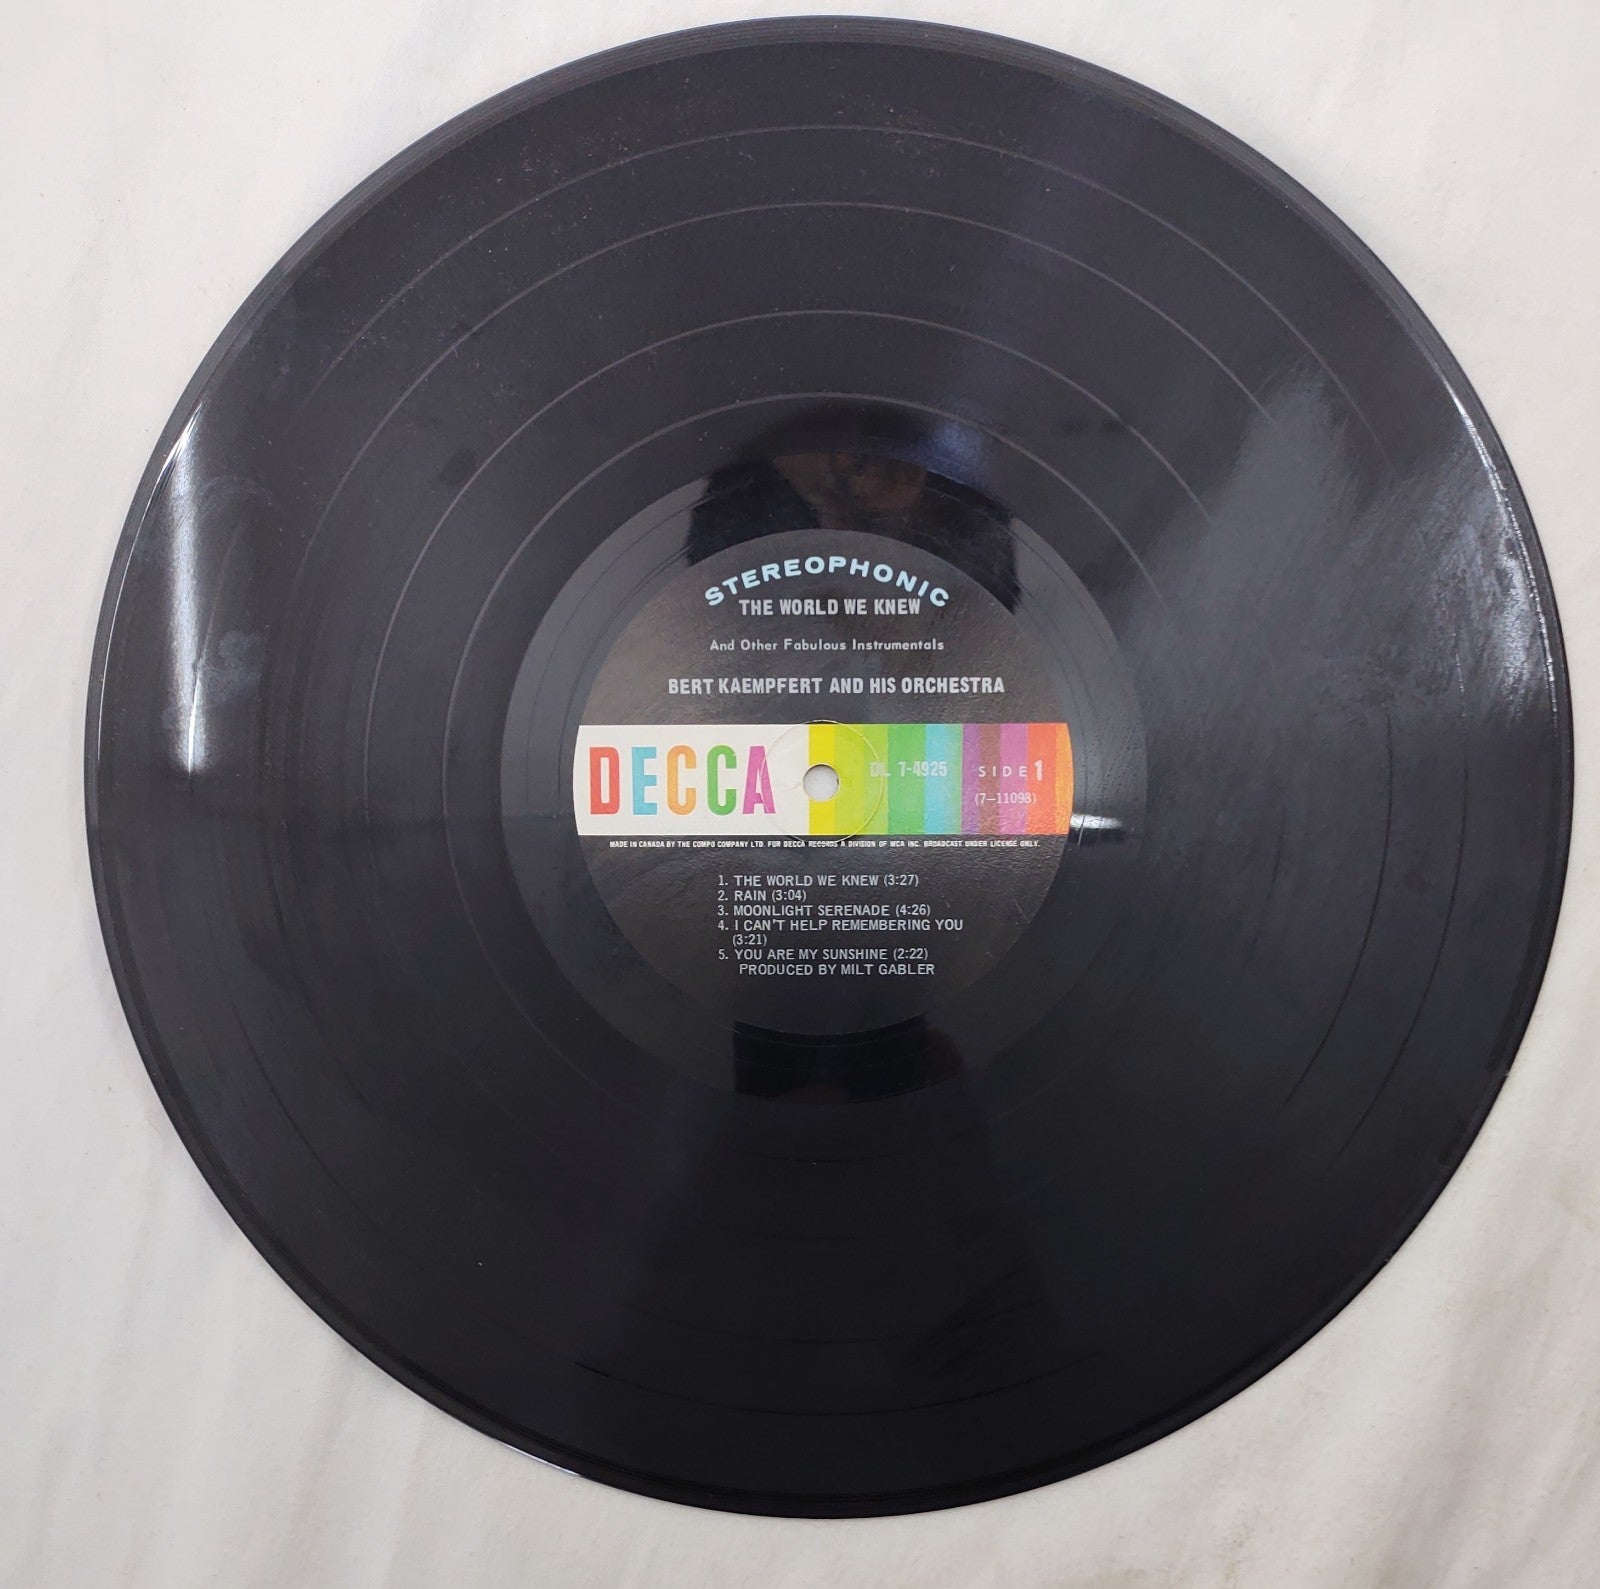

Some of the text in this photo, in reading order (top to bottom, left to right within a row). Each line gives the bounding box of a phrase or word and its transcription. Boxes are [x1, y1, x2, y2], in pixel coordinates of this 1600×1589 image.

[705, 556, 949, 607] STEREOPHONIC
[739, 599, 921, 616] THE WORLD WE KNEW
[709, 639, 944, 651] And Other Fabulous Instrumentals
[669, 677, 1005, 694] BERT KAEMPFERT AND HIS ORCHESTRA
[898, 762, 948, 777] 7-4925
[978, 760, 1043, 781] SIDE 1
[589, 745, 776, 815] DECCA
[609, 840, 628, 848] MADE
[629, 840, 638, 848] IN
[638, 840, 665, 848] CANADA
[666, 840, 675, 848] BY
[677, 840, 691, 848] THE
[717, 840, 749, 848] COMPANY
[783, 840, 806, 848] DECCA
[808, 840, 838, 848] RECORDS
[840, 840, 846, 848] A
[848, 840, 876, 848] DIVISION
[878, 840, 888, 848] OF
[890, 840, 905, 848] MCA
[923, 840, 963, 848] BROADCAST
[965, 840, 988, 848] UNDER
[990, 840, 1018, 848] LICENSE
[718, 874, 919, 887] 1. THE WORLD WE KNEW (3:27)
[717, 889, 807, 902] 2. RAIN (3:04)
[717, 904, 931, 917] 3. MOONLIGHT SERENADE (4:26)
[717, 919, 963, 931] 4. I CAN'T HELP REMEMBERING YOU
[732, 933, 767, 946] (3:21)
[718, 948, 929, 961] 5. YOU ARE MY SUNSHINE (2:22)
[739, 964, 935, 975] PRODUCED BY MILT GABLER
